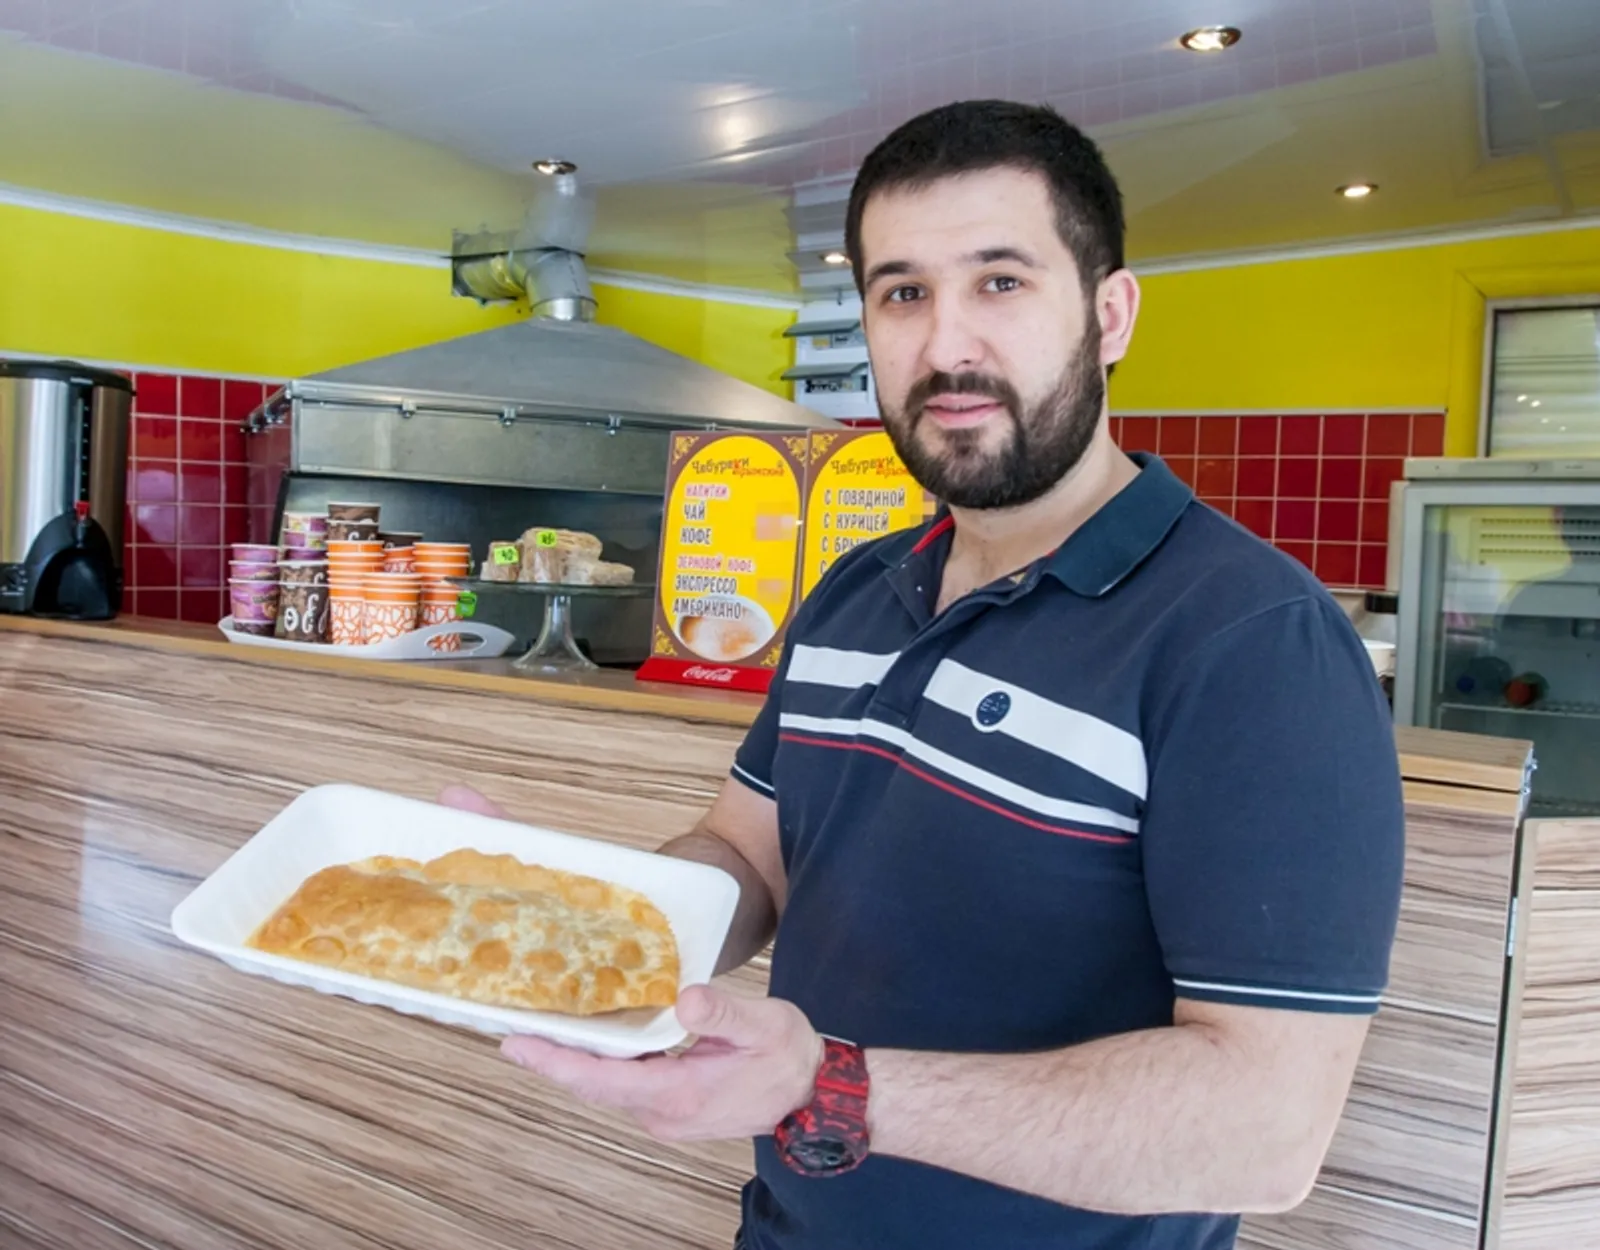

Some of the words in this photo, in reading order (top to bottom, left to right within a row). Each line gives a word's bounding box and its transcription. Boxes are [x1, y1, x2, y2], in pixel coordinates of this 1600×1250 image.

[823, 488, 832, 505] С
[837, 486, 906, 508] ГОВЯДИНОЙ
[684, 499, 706, 521] ЧАЙ
[822, 512, 831, 529] С
[836, 511, 890, 533] КУРИЦЕЙ
[680, 527, 712, 545] КОФЕ
[820, 535, 829, 553] С
[727, 557, 755, 573] КОФЕ
[674, 573, 738, 595] ЭКСПРЕССО
[672, 597, 742, 620] АМЕРИКАНО
